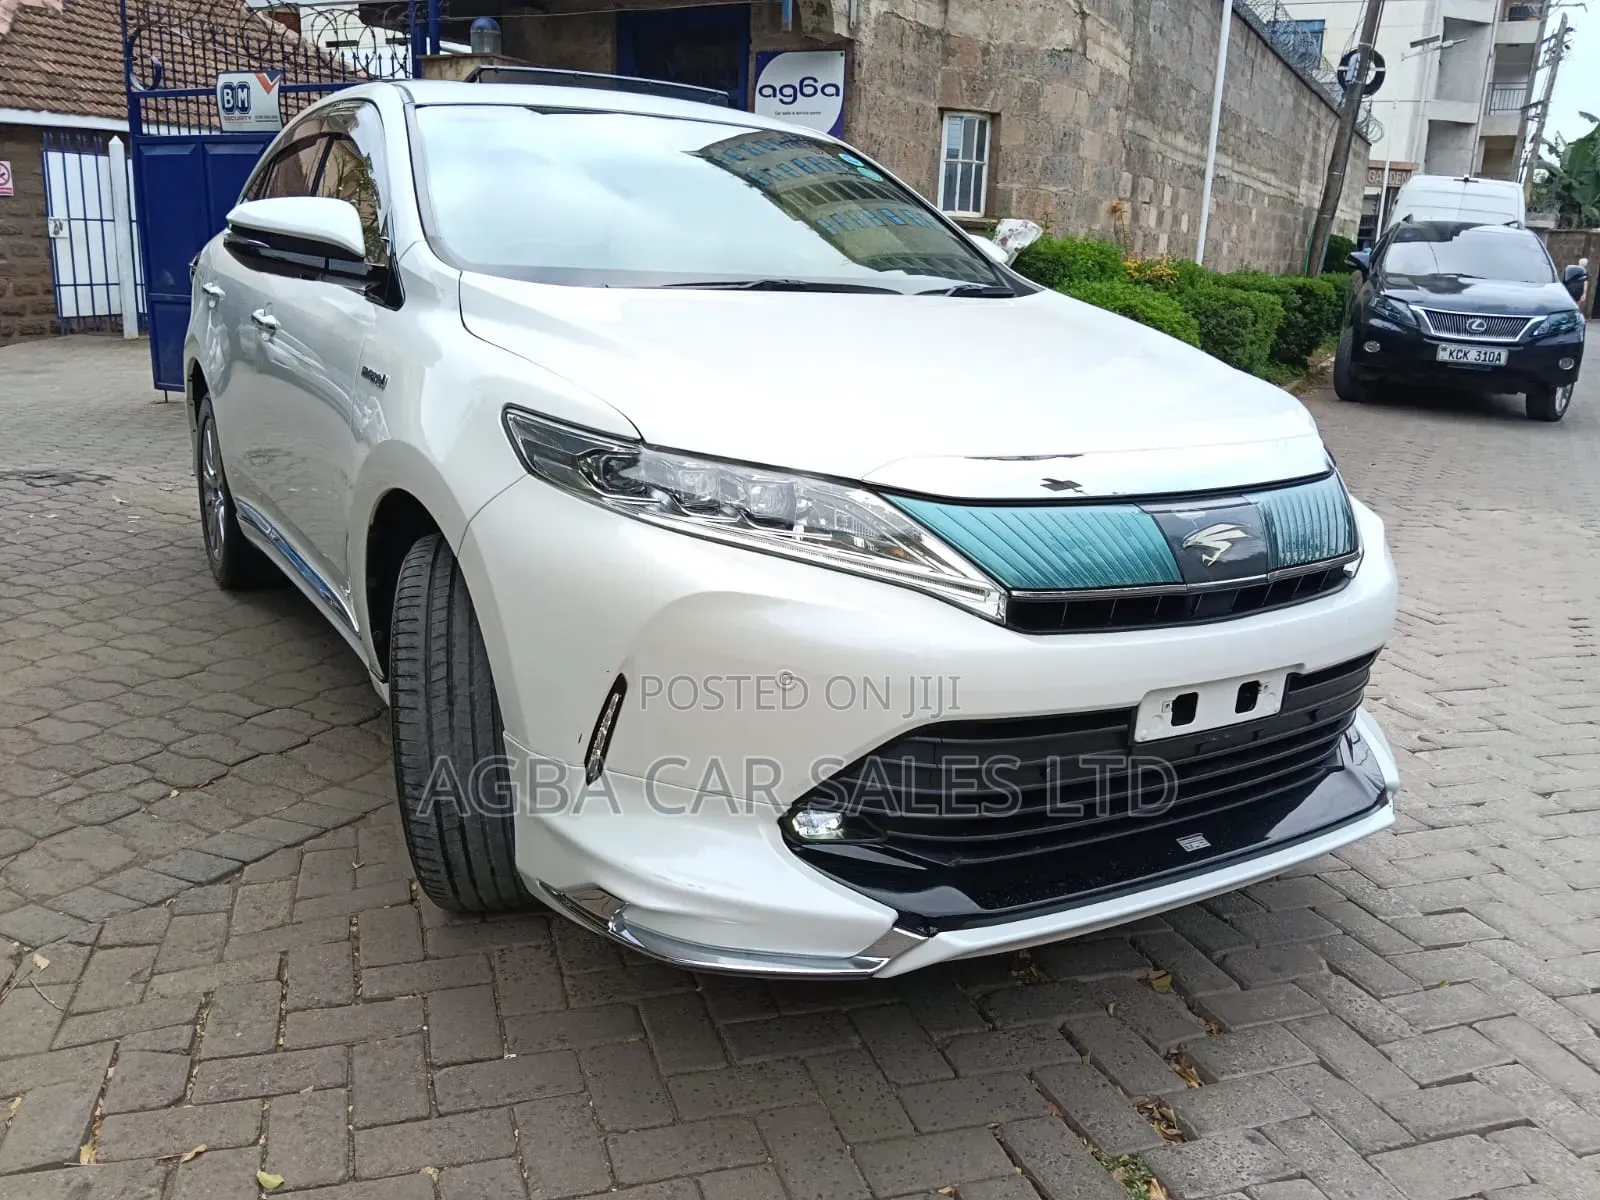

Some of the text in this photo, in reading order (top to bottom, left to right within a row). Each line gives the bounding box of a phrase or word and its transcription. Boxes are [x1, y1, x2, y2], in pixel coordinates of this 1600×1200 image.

[222, 86, 249, 110] BM
[1448, 348, 1502, 363] KCK 310A
